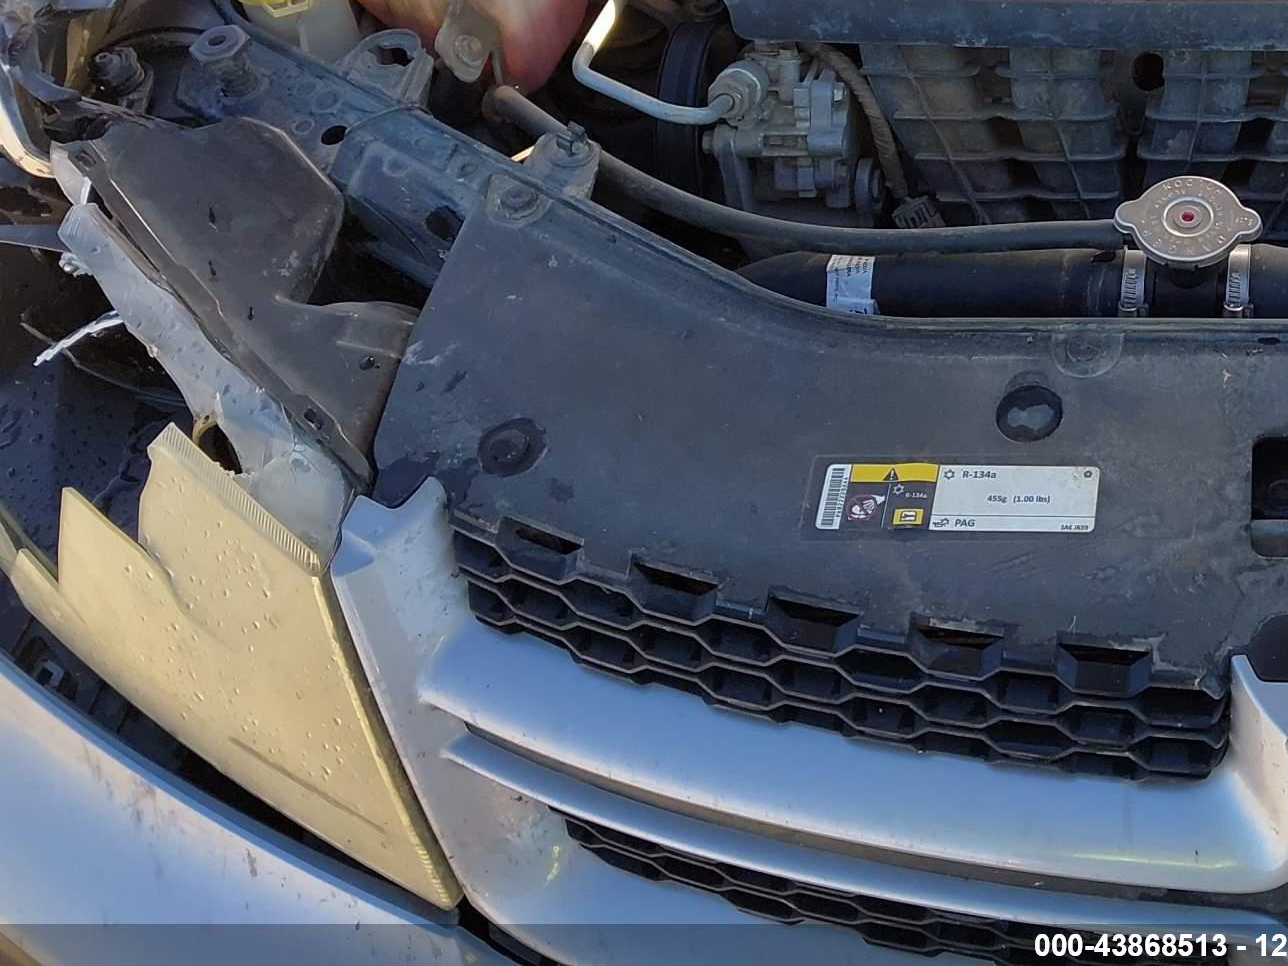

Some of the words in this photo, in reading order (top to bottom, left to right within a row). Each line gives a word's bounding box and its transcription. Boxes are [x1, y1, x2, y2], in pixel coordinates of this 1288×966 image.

[962, 470, 997, 479] R-134a
[987, 495, 1007, 503] 455g
[1013, 495, 1034, 504] (1.00
[1036, 495, 1050, 504] lbs)
[954, 519, 975, 527] PAG
